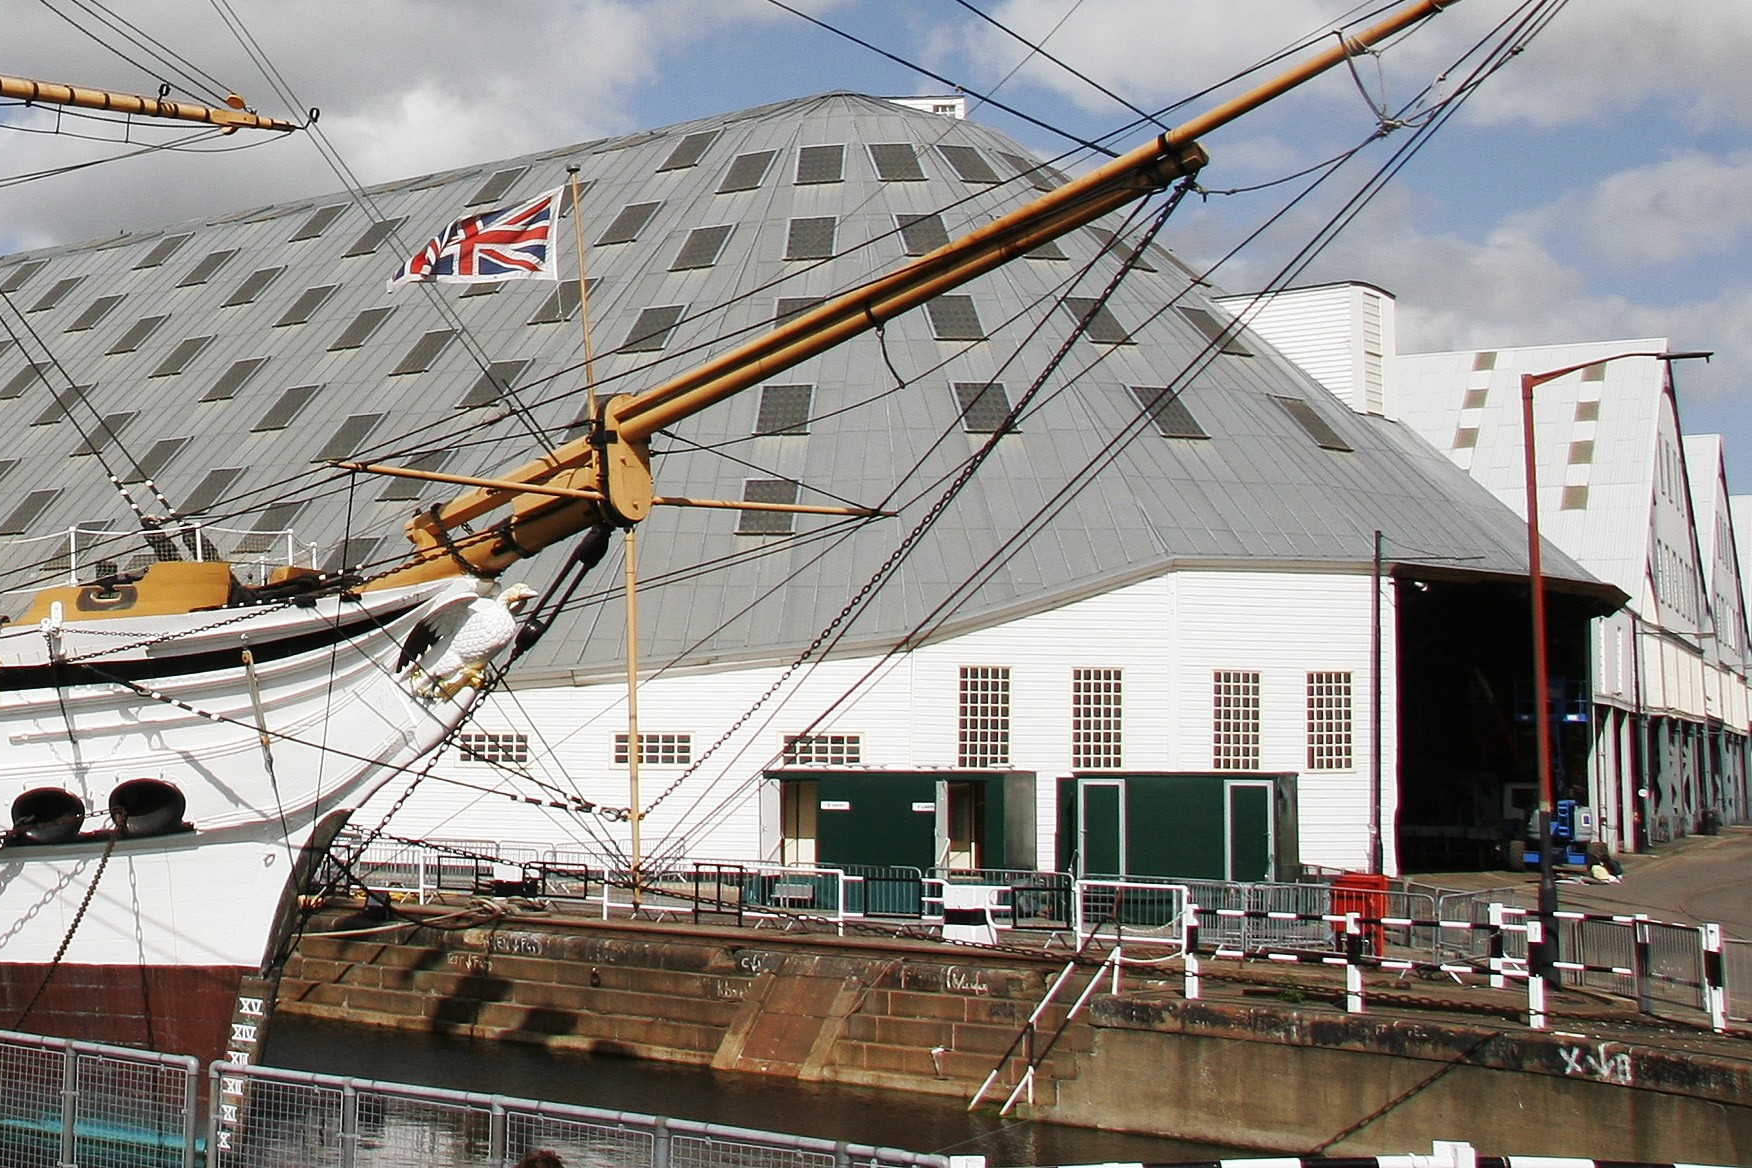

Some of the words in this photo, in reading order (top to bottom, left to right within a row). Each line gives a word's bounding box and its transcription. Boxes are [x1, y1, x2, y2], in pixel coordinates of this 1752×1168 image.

[238, 997, 264, 1015] XV
[231, 1023, 257, 1042] XIV
[222, 1077, 244, 1096] XII
[221, 1104, 238, 1122] XI
[217, 1130, 231, 1149] X
